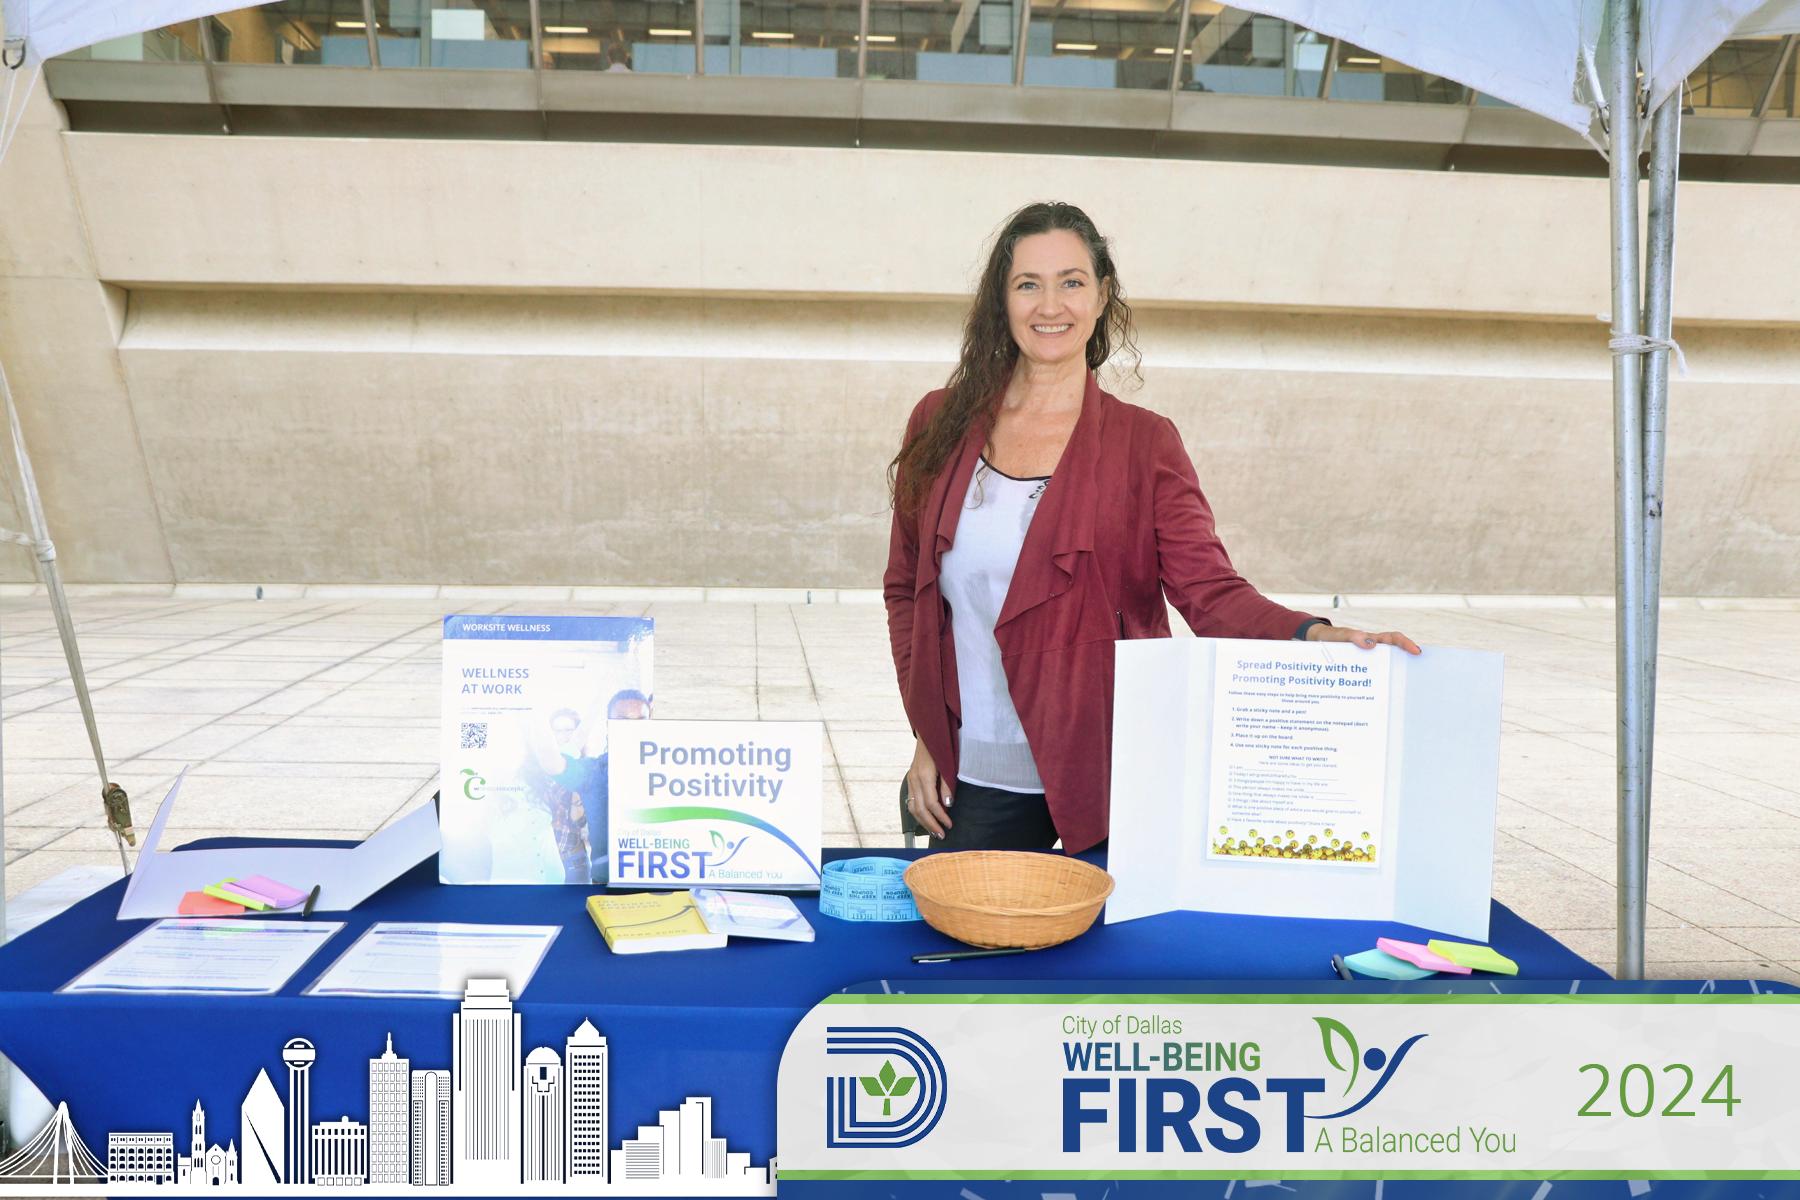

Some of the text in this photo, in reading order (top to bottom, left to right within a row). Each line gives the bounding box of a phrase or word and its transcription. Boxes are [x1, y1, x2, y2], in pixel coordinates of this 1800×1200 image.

[462, 623, 552, 632] WORKSITE WELLNESS
[1237, 660, 1368, 673] Spread Positivity with the
[462, 667, 529, 679] WELLNESS
[1232, 673, 1372, 688] Promoting Positivity Board!
[461, 683, 522, 695] AT WORK
[639, 741, 792, 772] Promoting
[648, 773, 783, 803] Positivity
[618, 838, 690, 849] WELL-BEING
[618, 851, 712, 879] FIRST
[709, 869, 783, 880] A Balanced You
